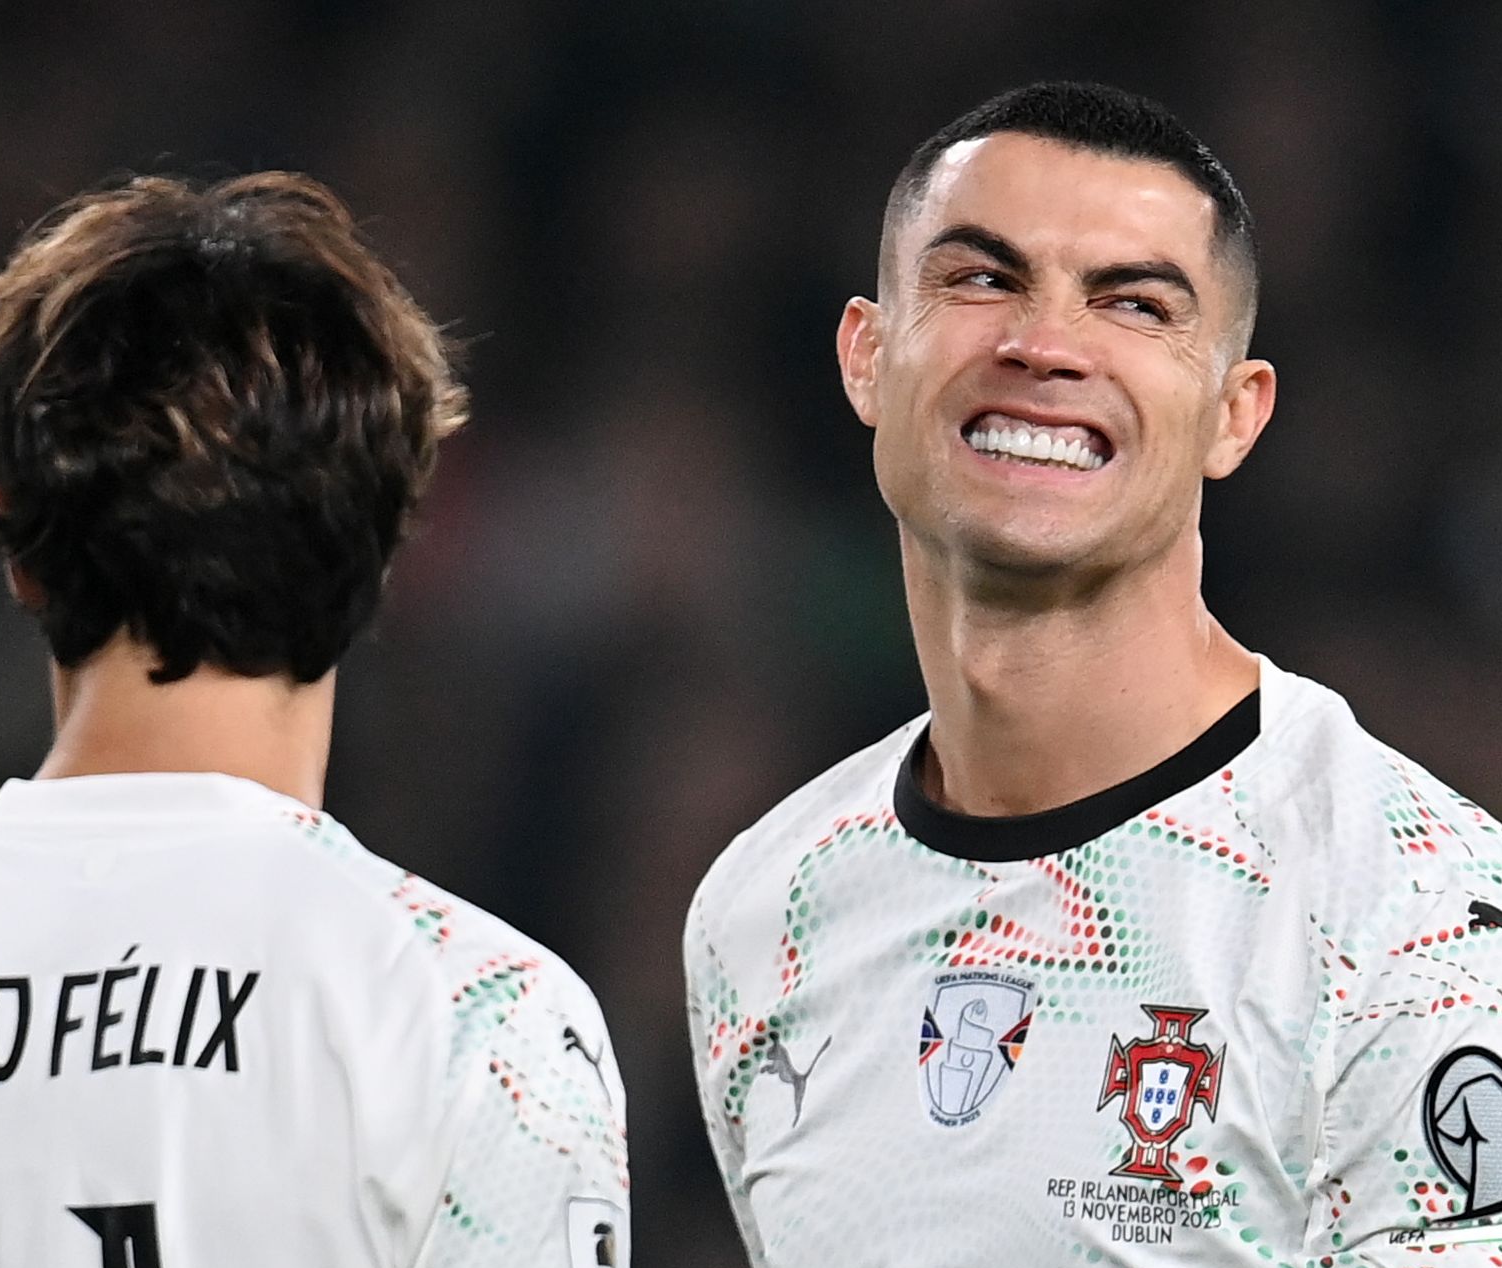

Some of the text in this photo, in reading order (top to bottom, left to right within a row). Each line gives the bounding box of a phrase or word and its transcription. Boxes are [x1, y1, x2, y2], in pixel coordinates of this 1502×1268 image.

[935, 971, 1035, 991] UEFA NATIONS LEAGUE
[49, 943, 261, 1079] FÉLIX
[1047, 1178, 1076, 1199] REP.
[1063, 1200, 1221, 1230] 13 NOVEMBRO 2025
[1112, 1224, 1172, 1244] DUBLIN
[1389, 1230, 1425, 1245] UEFA
